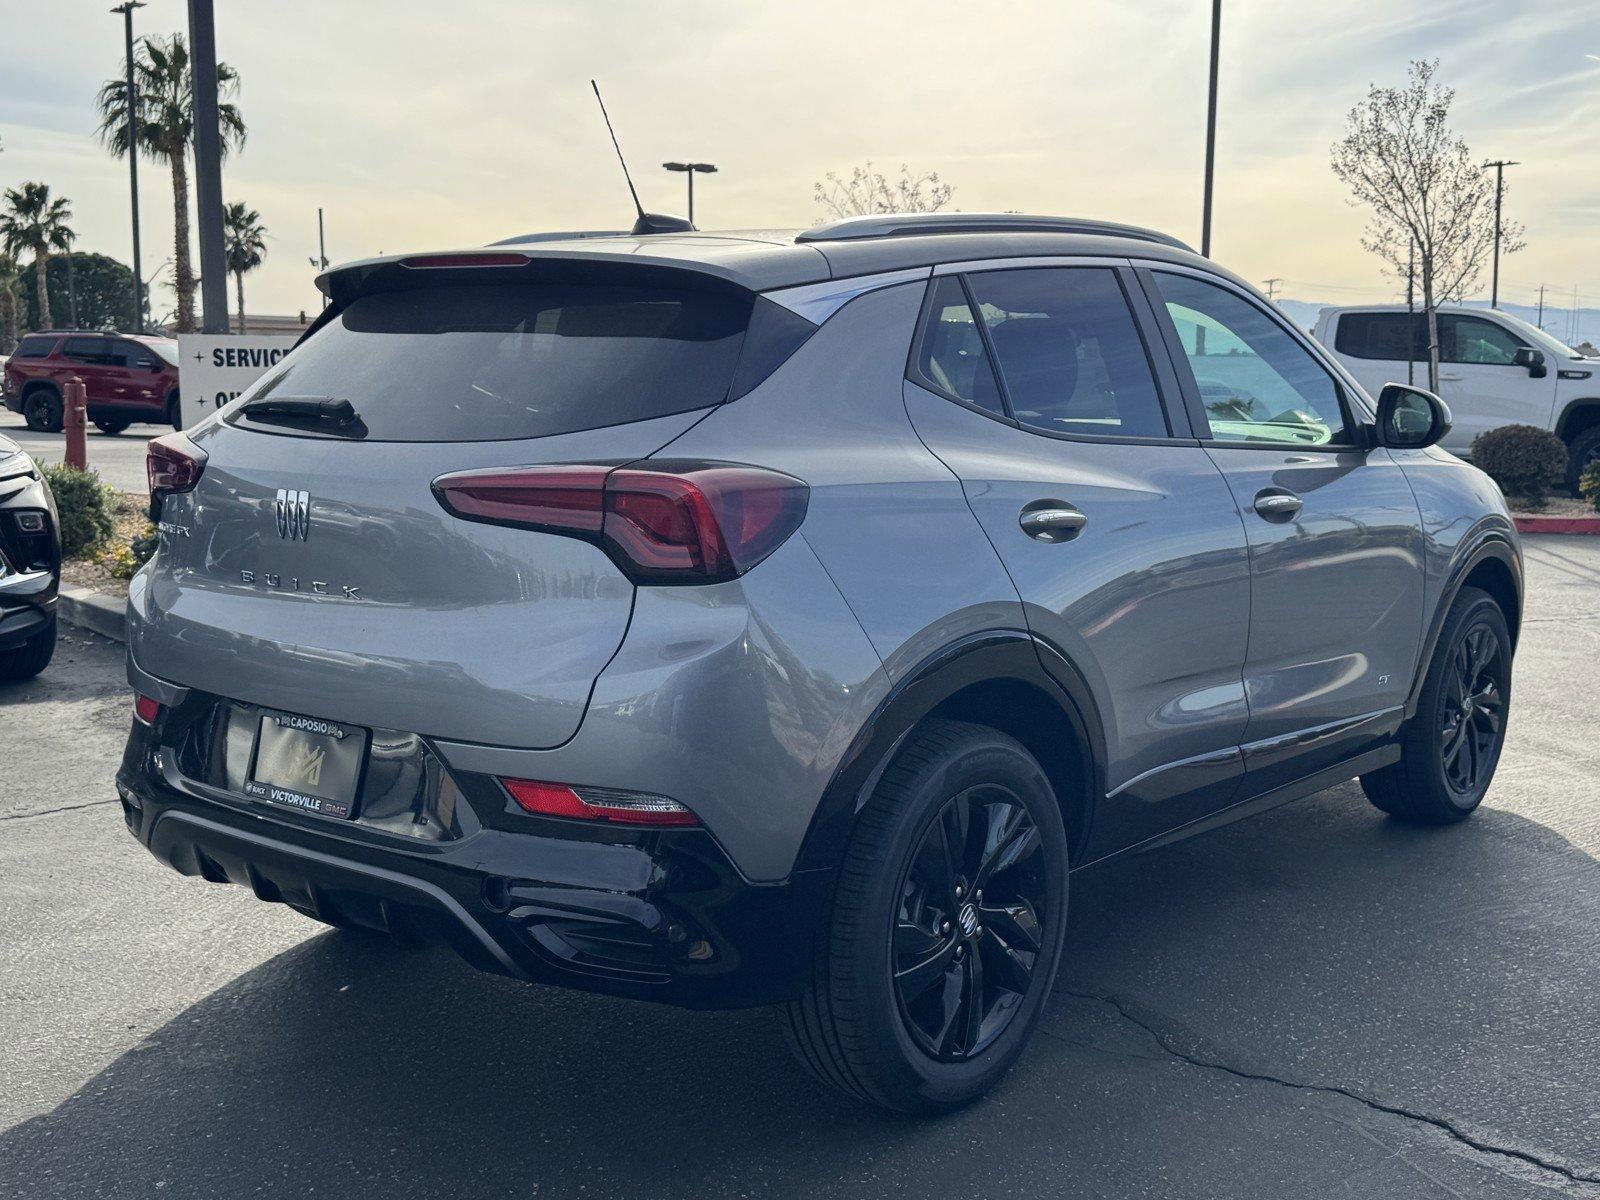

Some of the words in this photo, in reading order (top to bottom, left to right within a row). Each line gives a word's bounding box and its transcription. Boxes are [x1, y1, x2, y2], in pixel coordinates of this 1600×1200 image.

[241, 570, 360, 600] BUICK
[291, 717, 328, 733] CAPOSIO
[271, 789, 321, 810] VICTORVILLE
[325, 803, 347, 815] GMC
